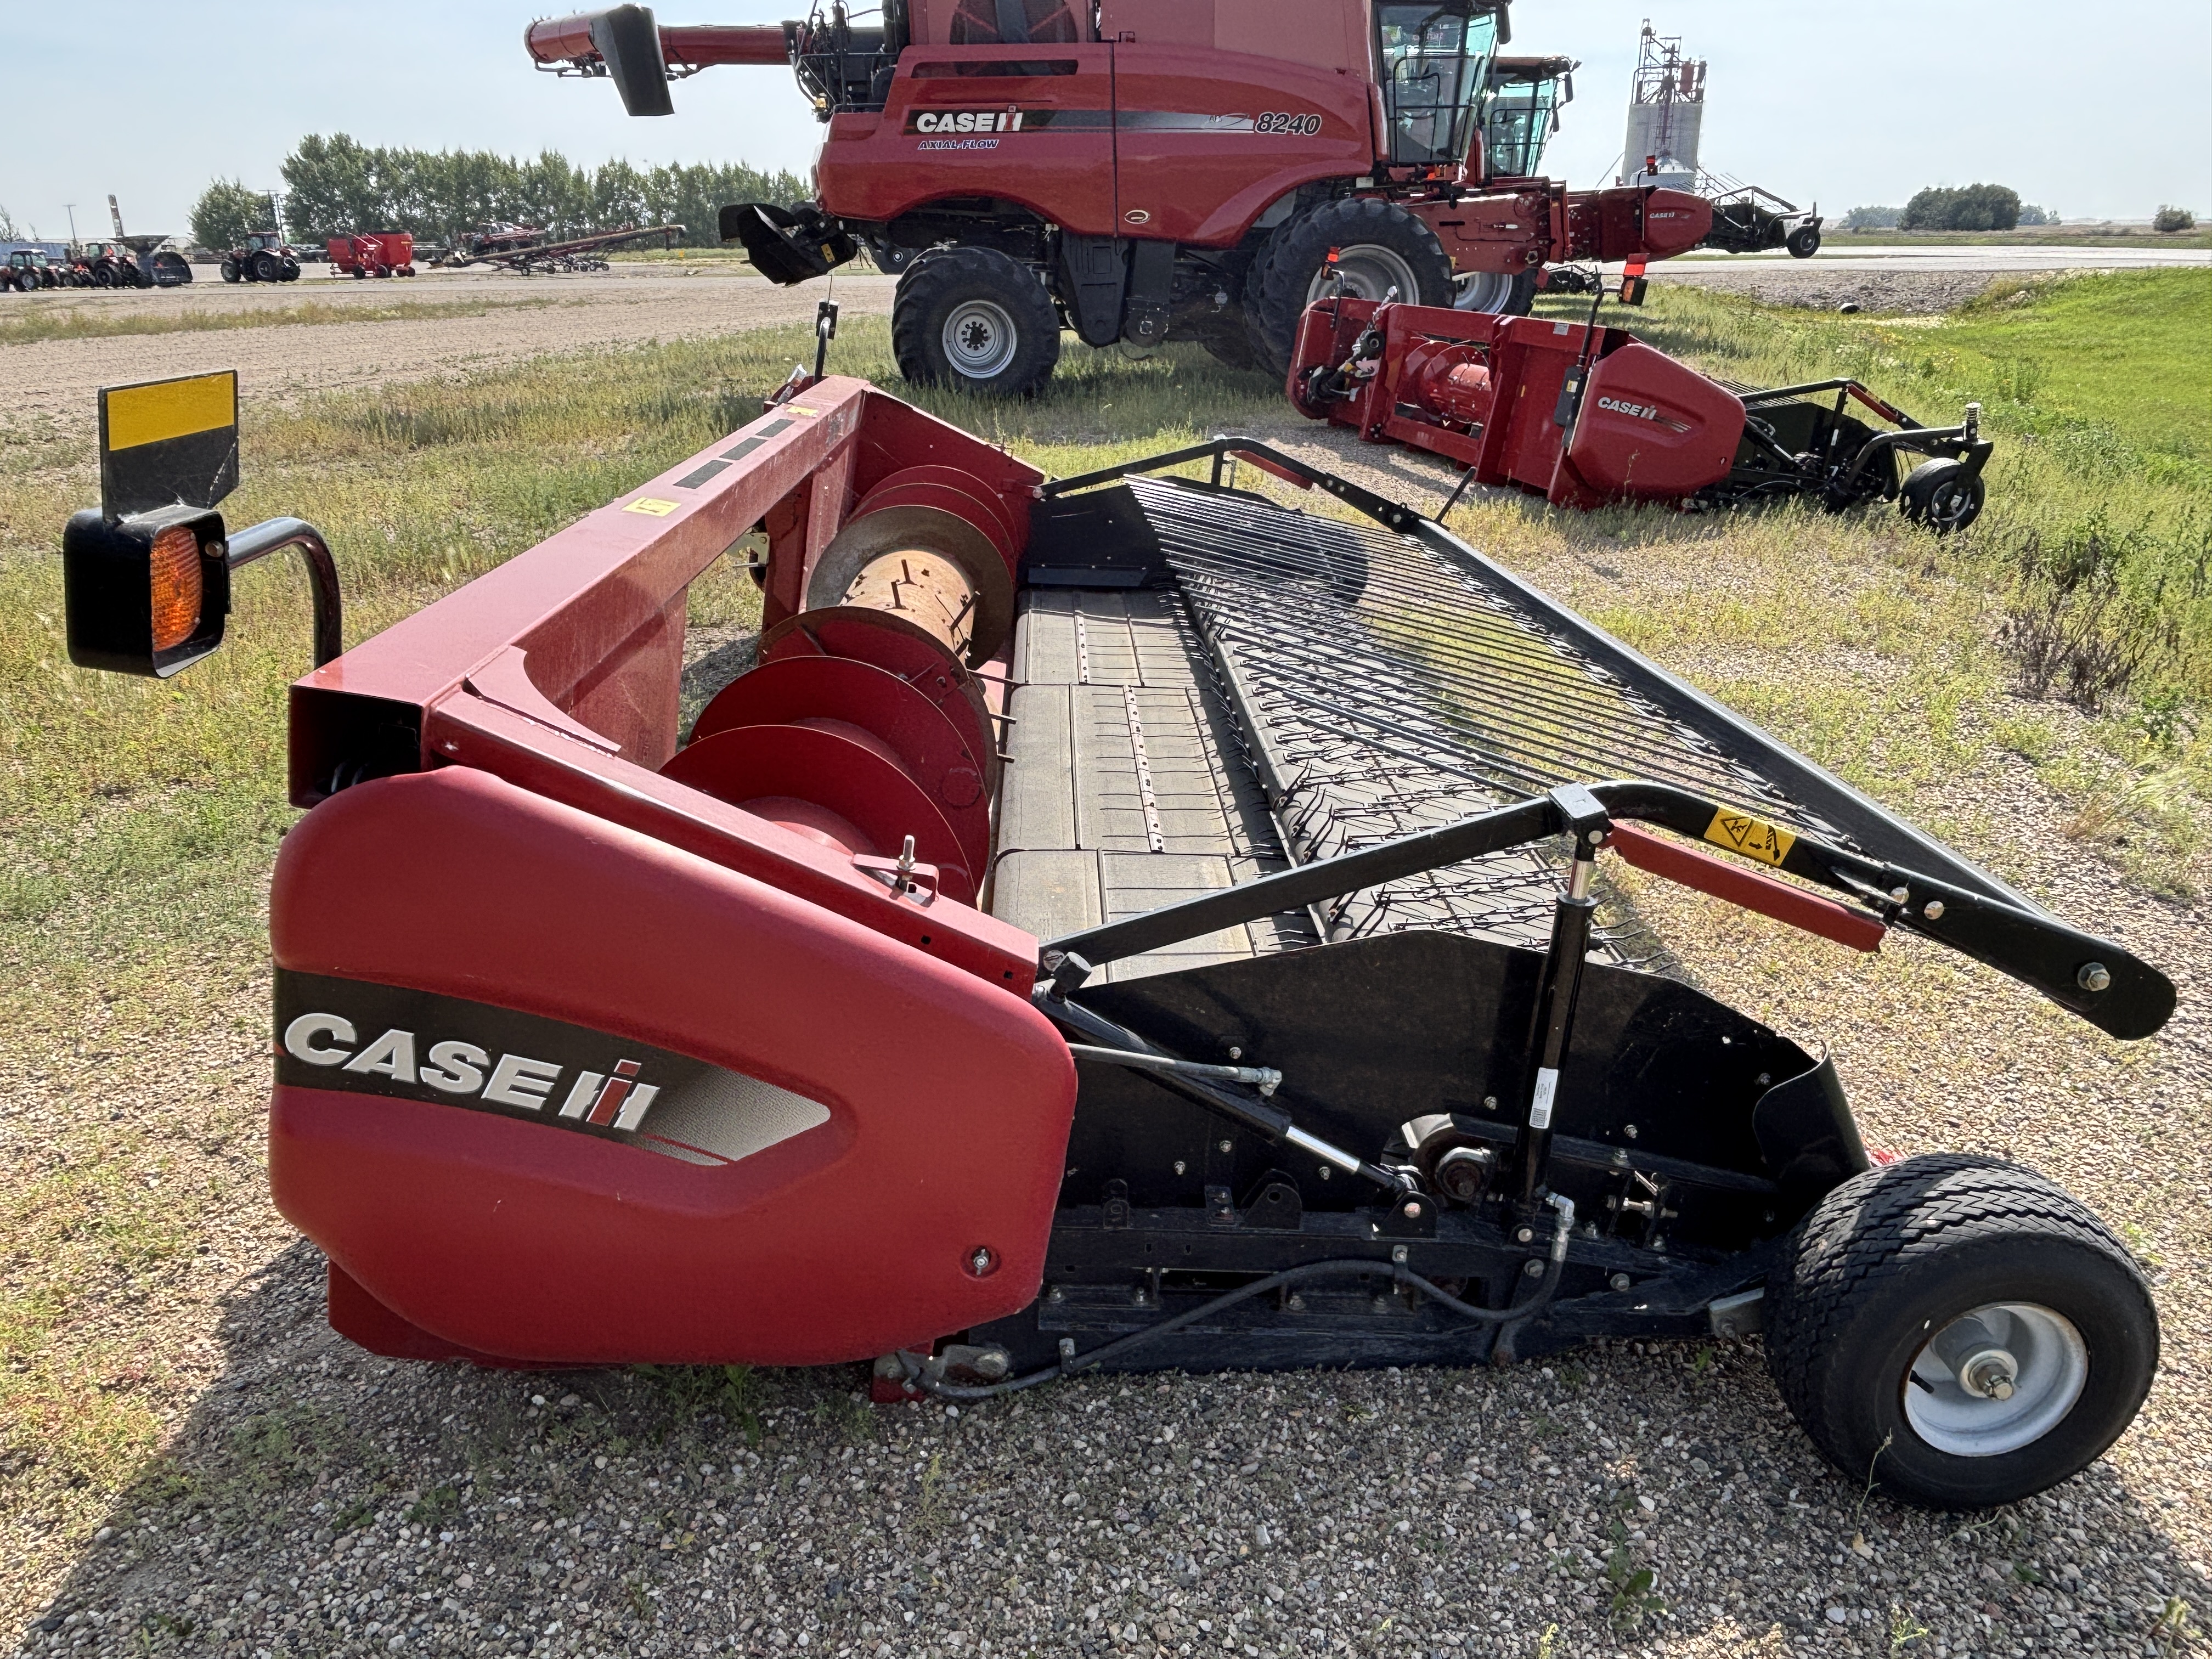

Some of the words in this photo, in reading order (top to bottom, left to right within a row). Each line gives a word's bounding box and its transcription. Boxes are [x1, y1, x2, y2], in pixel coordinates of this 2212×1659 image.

[917, 113, 995, 132] CASE
[1255, 111, 1322, 136] 8240
[918, 139, 1000, 150] AXIAL-FLOW
[1598, 397, 1642, 416] CASE
[285, 1012, 563, 1111] CASE
